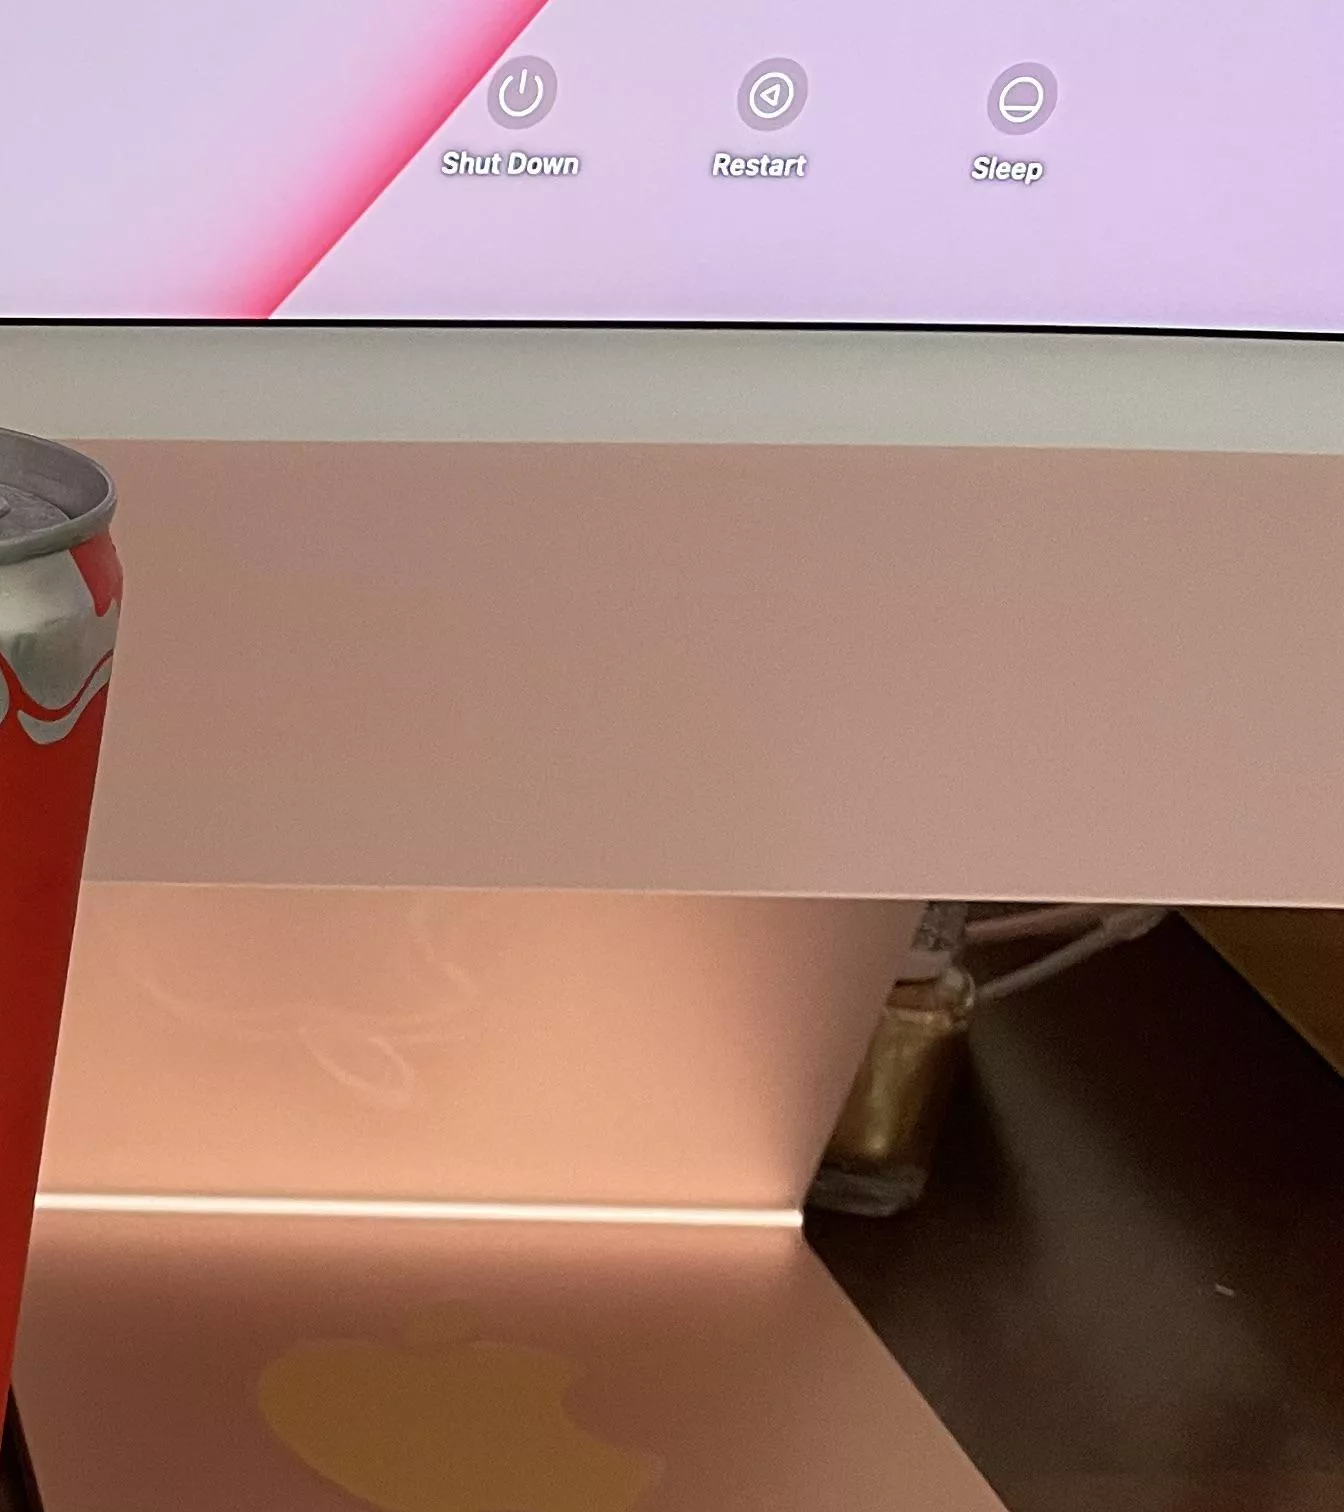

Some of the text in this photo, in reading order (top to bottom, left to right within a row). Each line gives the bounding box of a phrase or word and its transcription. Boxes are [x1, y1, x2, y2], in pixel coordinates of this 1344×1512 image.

[441, 150, 579, 175] Shut Down
[712, 152, 807, 177] Restart
[971, 155, 1043, 185] Sleep
